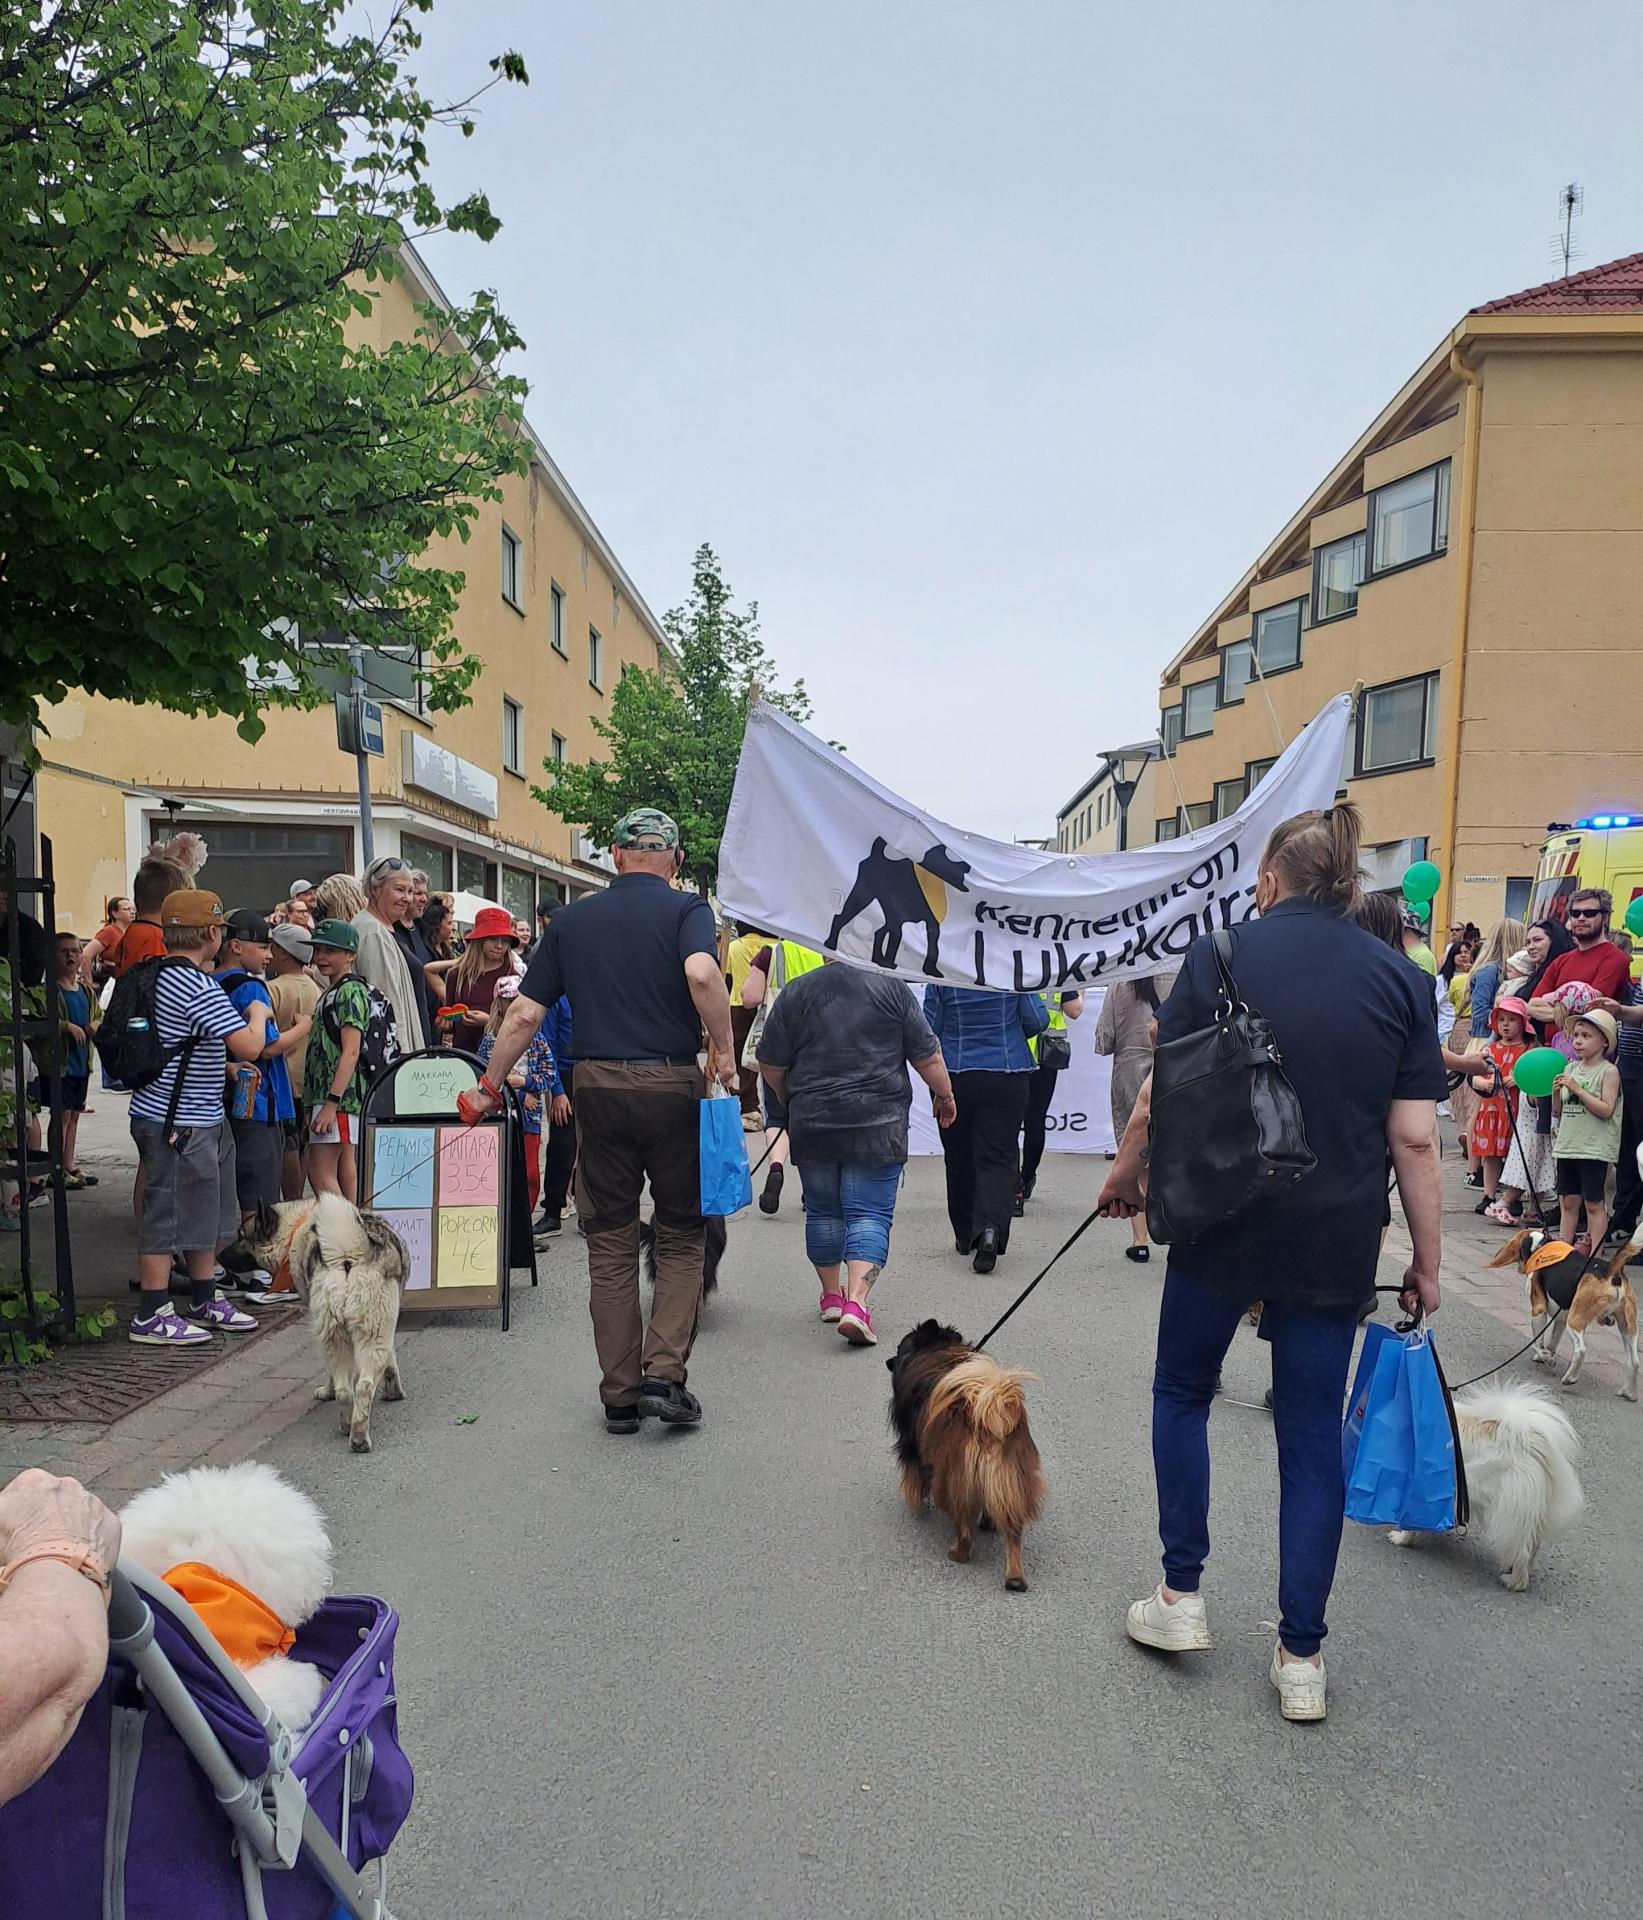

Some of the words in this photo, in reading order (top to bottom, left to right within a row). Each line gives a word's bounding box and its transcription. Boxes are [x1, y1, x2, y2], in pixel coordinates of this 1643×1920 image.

[411, 1070, 453, 1081] MAKKARA
[378, 1134, 431, 1158] PEHMIS
[441, 1134, 497, 1160] HATTARA
[393, 1218, 425, 1231] OMAT
[440, 1214, 497, 1237] POPCORN
[451, 1239, 487, 1273] 4€
